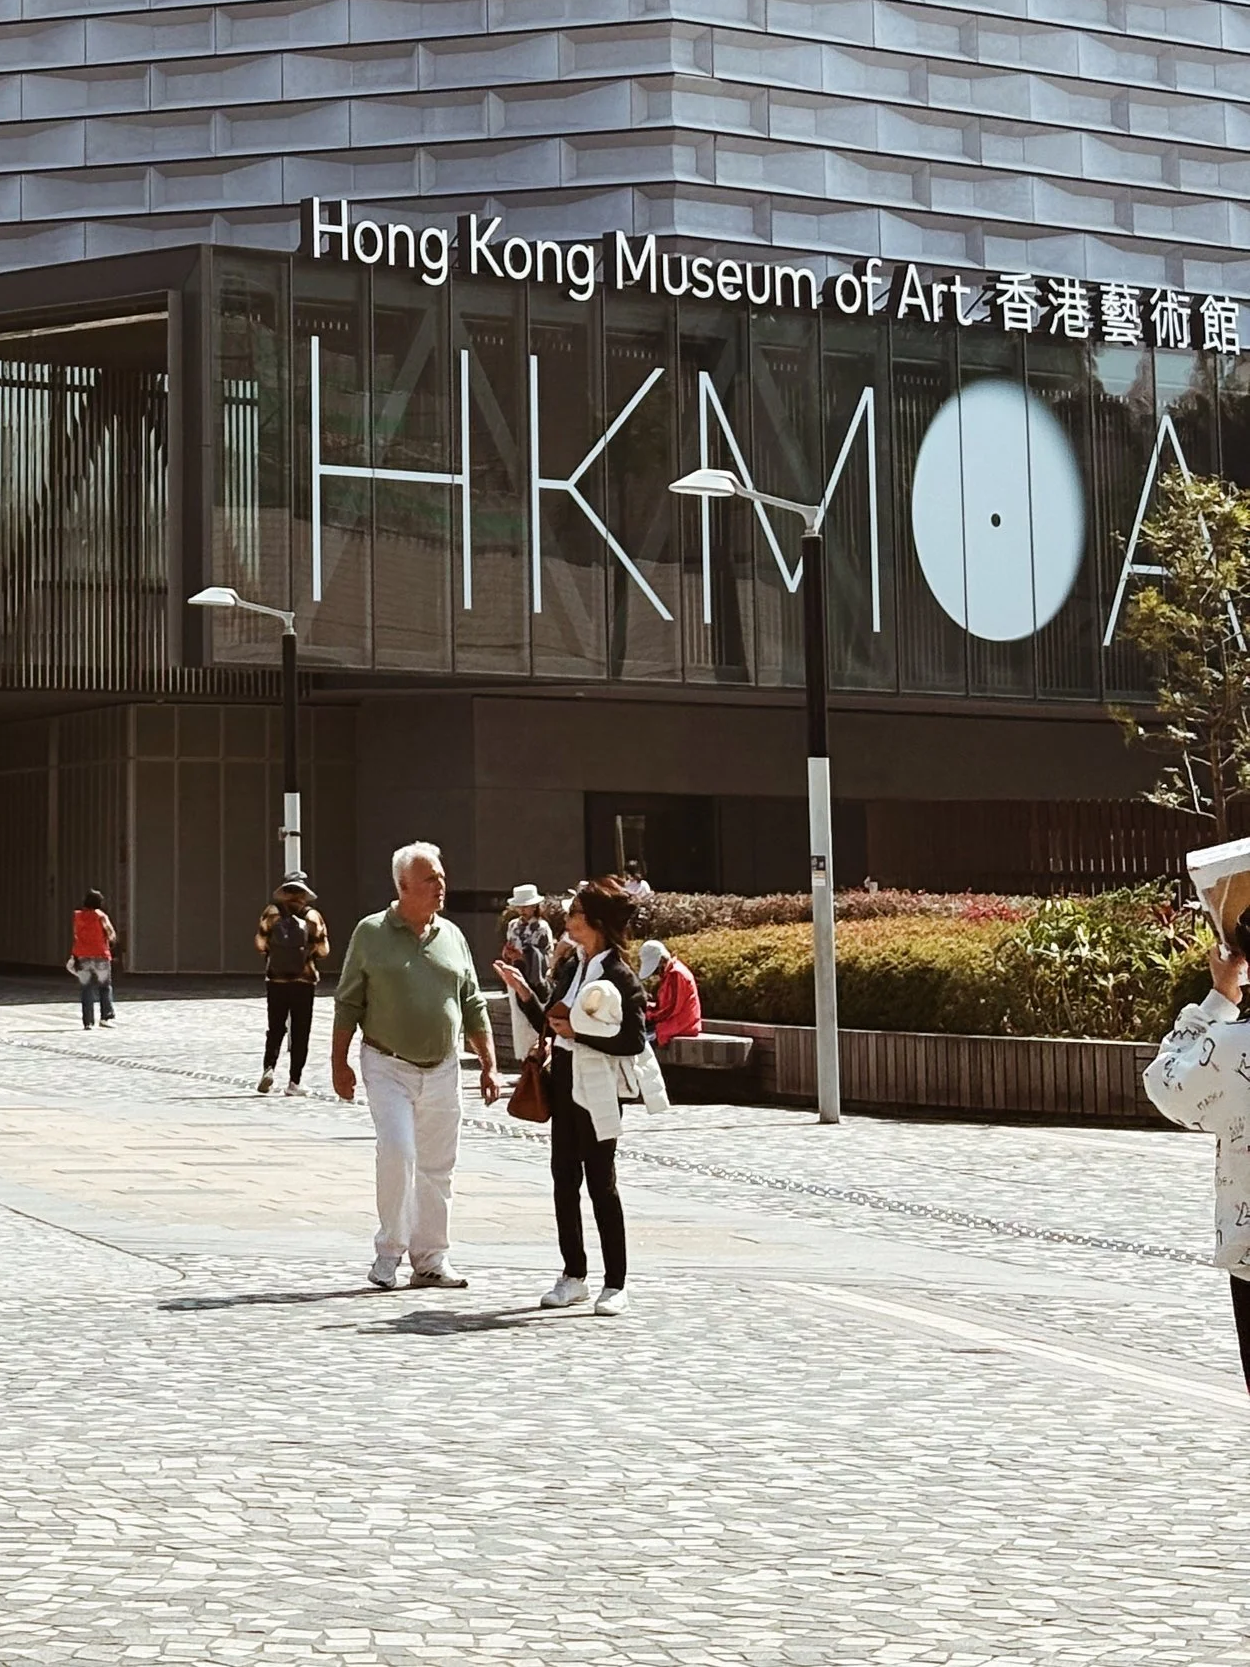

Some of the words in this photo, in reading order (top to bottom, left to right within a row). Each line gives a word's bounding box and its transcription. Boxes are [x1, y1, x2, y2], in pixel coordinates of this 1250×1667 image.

[312, 196, 449, 287] Hong
[469, 213, 595, 303] Kong
[615, 229, 818, 311] Museum
[834, 257, 883, 317] of
[896, 262, 975, 328] Art
[995, 272, 1242, 357] 香港藝術館
[310, 335, 1248, 652] HKMOA
